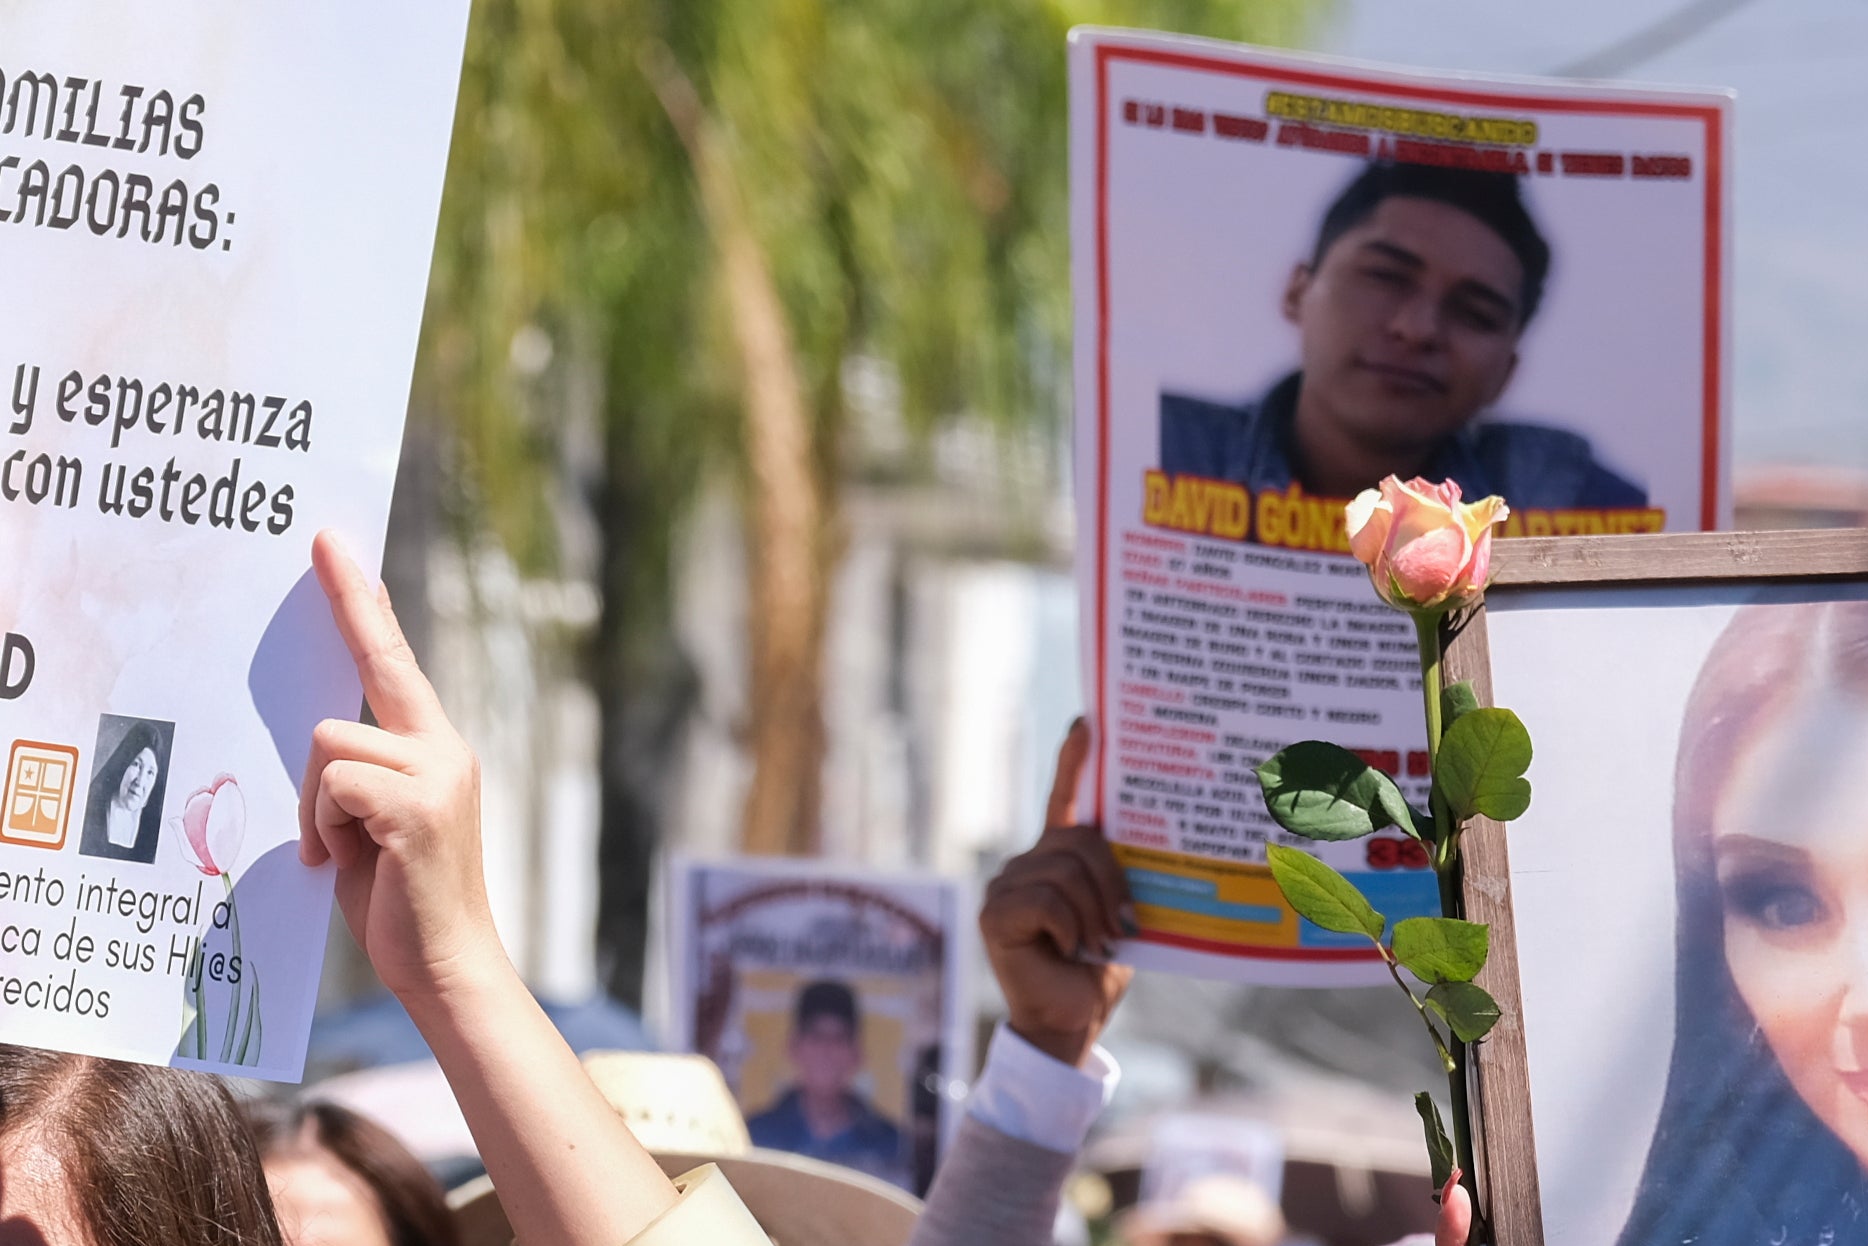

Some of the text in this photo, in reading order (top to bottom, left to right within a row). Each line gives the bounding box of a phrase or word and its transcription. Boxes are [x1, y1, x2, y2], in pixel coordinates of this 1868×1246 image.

[0, 67, 205, 160] MILIAS
[8, 362, 313, 453] y esperanza
[0, 449, 295, 536] con ustedes
[1143, 468, 1250, 542] DAVID
[76, 873, 204, 934] integral
[212, 901, 233, 930] a
[53, 916, 95, 964] de
[105, 939, 156, 973] sus
